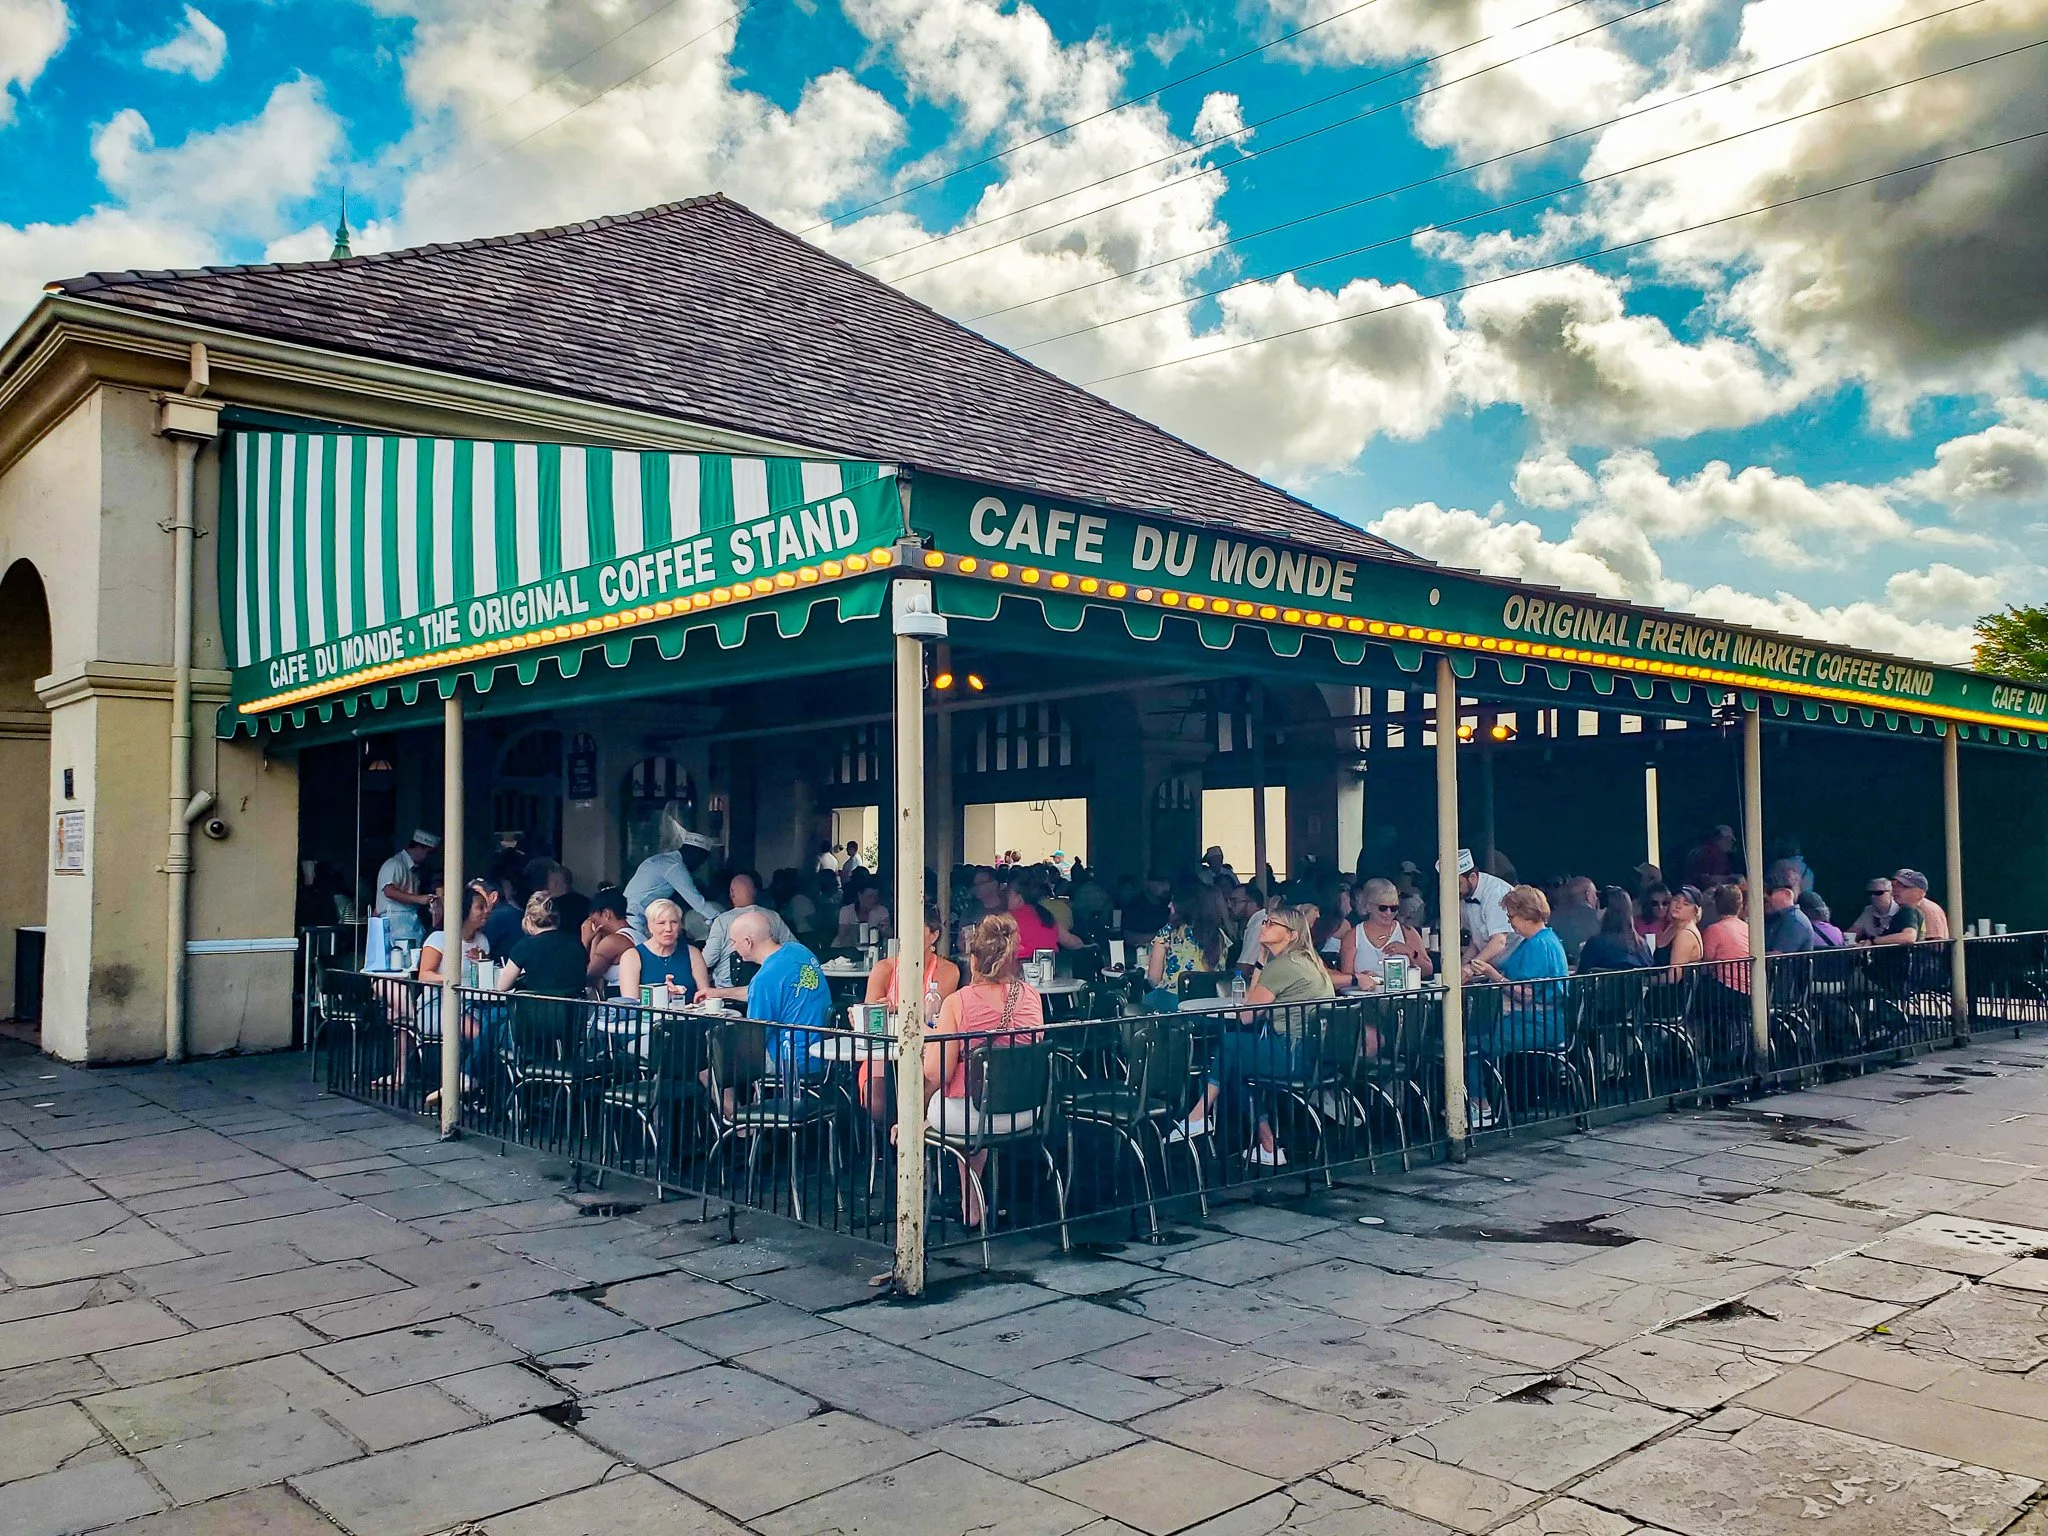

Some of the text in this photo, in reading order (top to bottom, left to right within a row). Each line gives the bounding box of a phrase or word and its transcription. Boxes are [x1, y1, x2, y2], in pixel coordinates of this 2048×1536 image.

[269, 497, 860, 689] CAFE DU MONDE THE ORIGINAL COFFEE STAND
[969, 496, 2047, 715] CAFE DU MONDE ORIGINAL FRENCH MARKET COFFEE STAND CAFE DU
